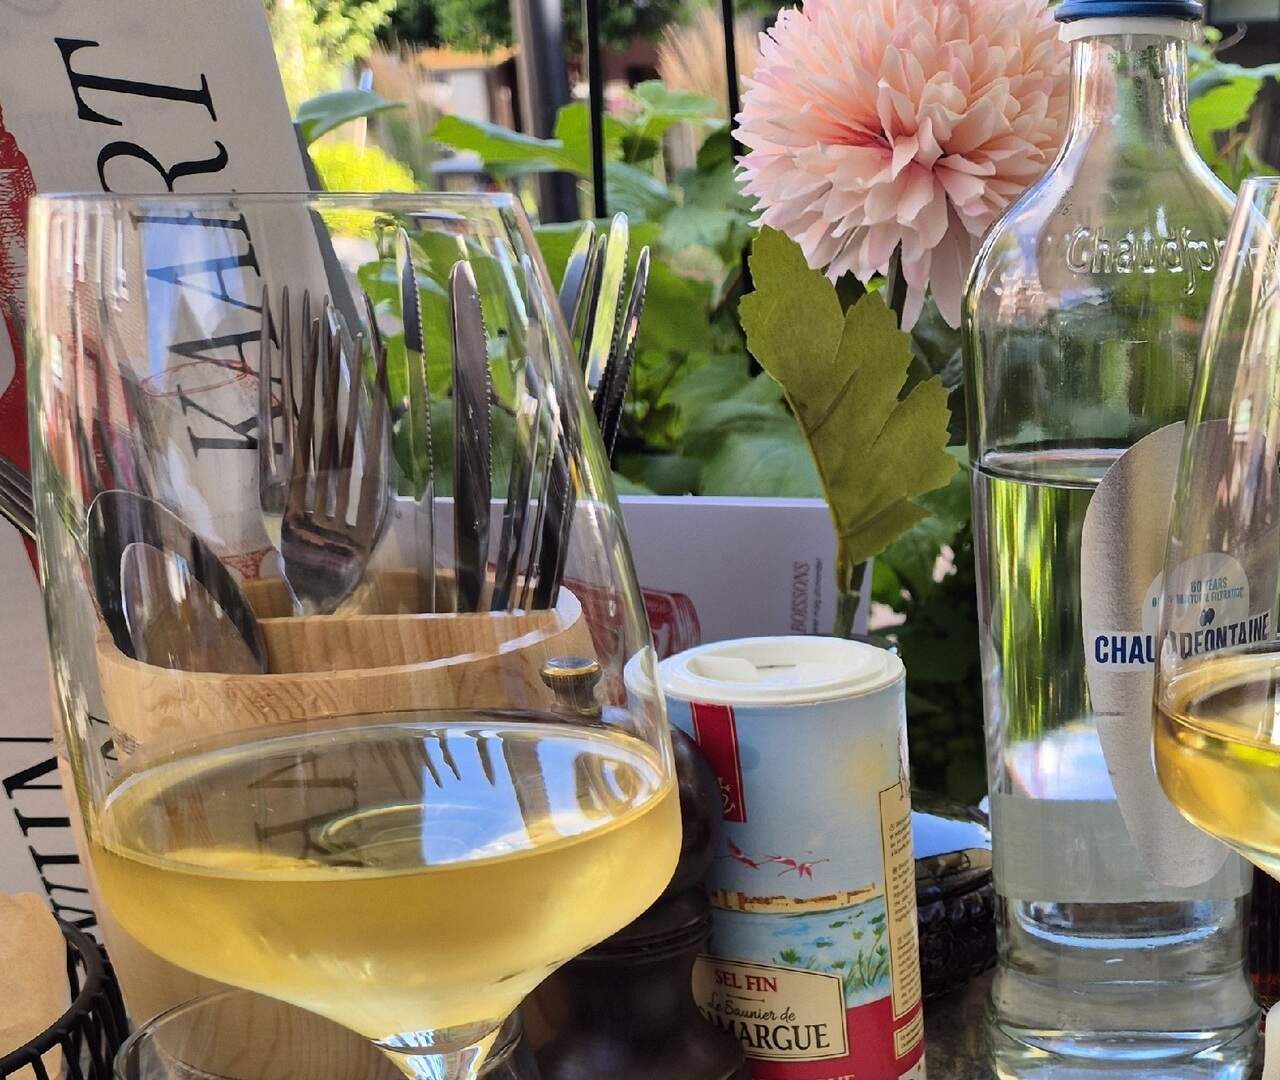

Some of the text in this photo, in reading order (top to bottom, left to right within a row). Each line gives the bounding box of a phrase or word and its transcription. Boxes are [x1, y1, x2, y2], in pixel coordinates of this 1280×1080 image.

[714, 968, 778, 993] SEL FIN
[724, 1001, 778, 1021] Saunier
[780, 1005, 796, 1021] de
